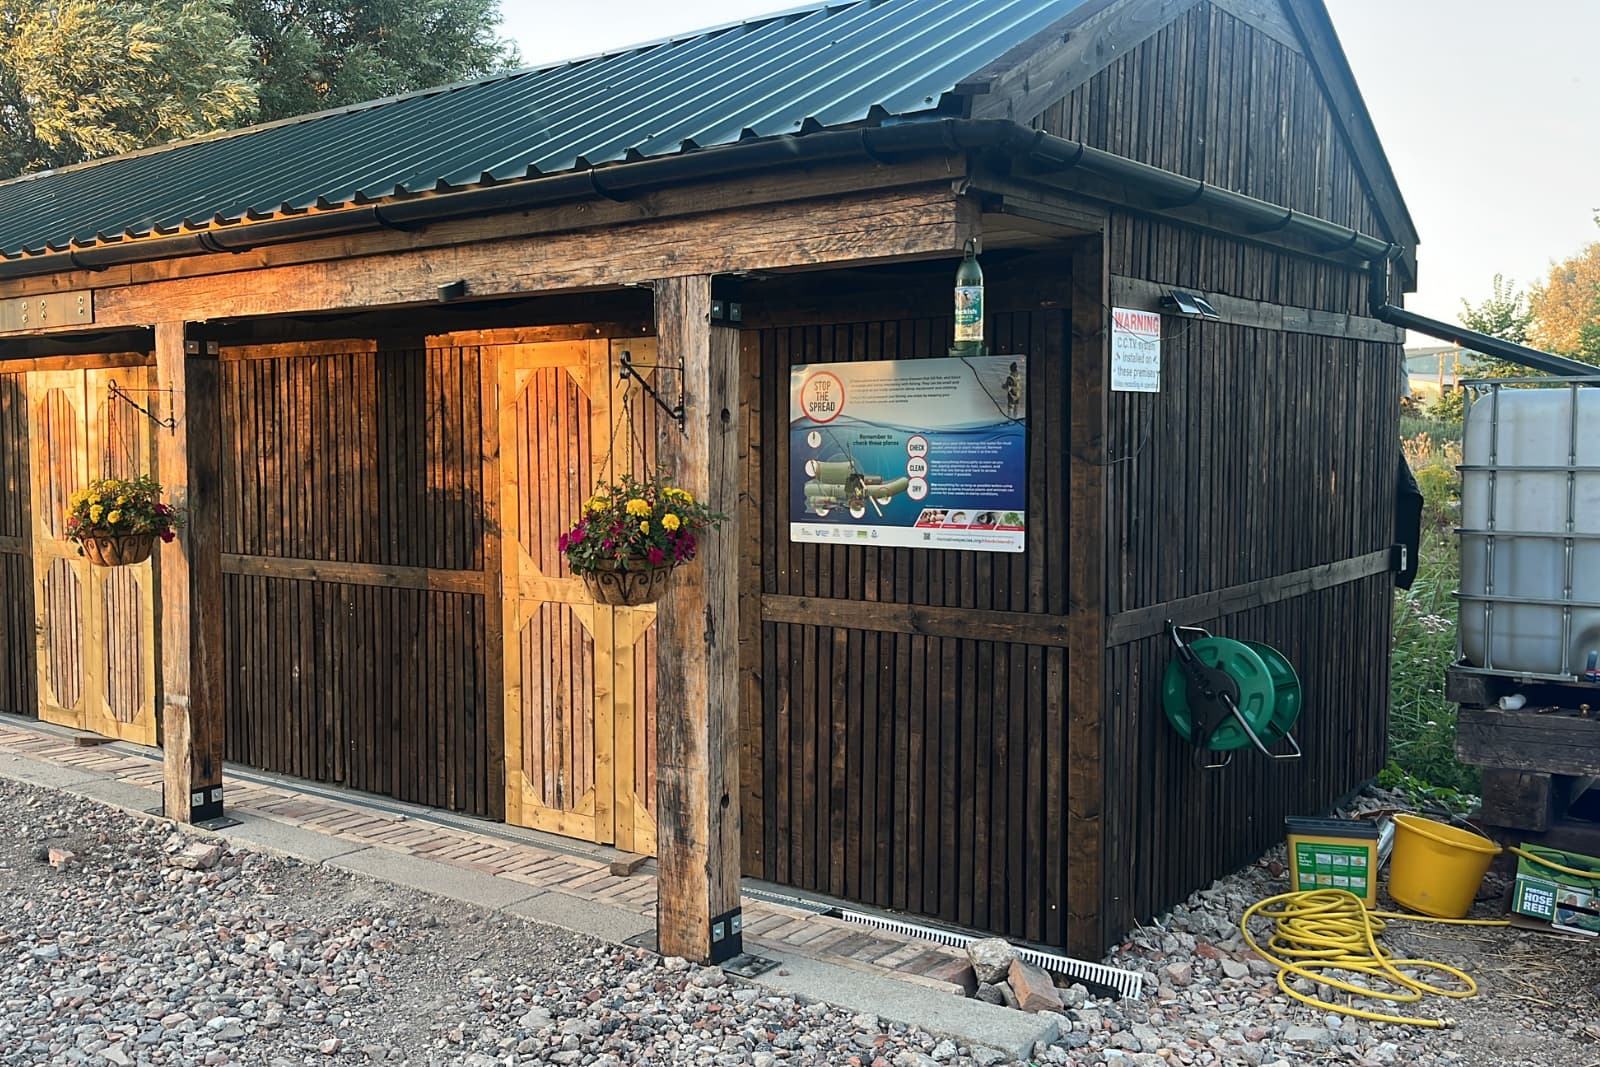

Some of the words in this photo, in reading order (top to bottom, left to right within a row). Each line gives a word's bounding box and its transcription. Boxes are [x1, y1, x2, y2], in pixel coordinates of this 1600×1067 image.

[1115, 311, 1159, 333] WARNING
[1117, 366, 1133, 377] these
[814, 381, 831, 391] STOP
[816, 391, 829, 401] THE
[809, 401, 835, 412] SPREAD
[1524, 892, 1553, 906] HOSE
[1523, 901, 1551, 916] REEL
